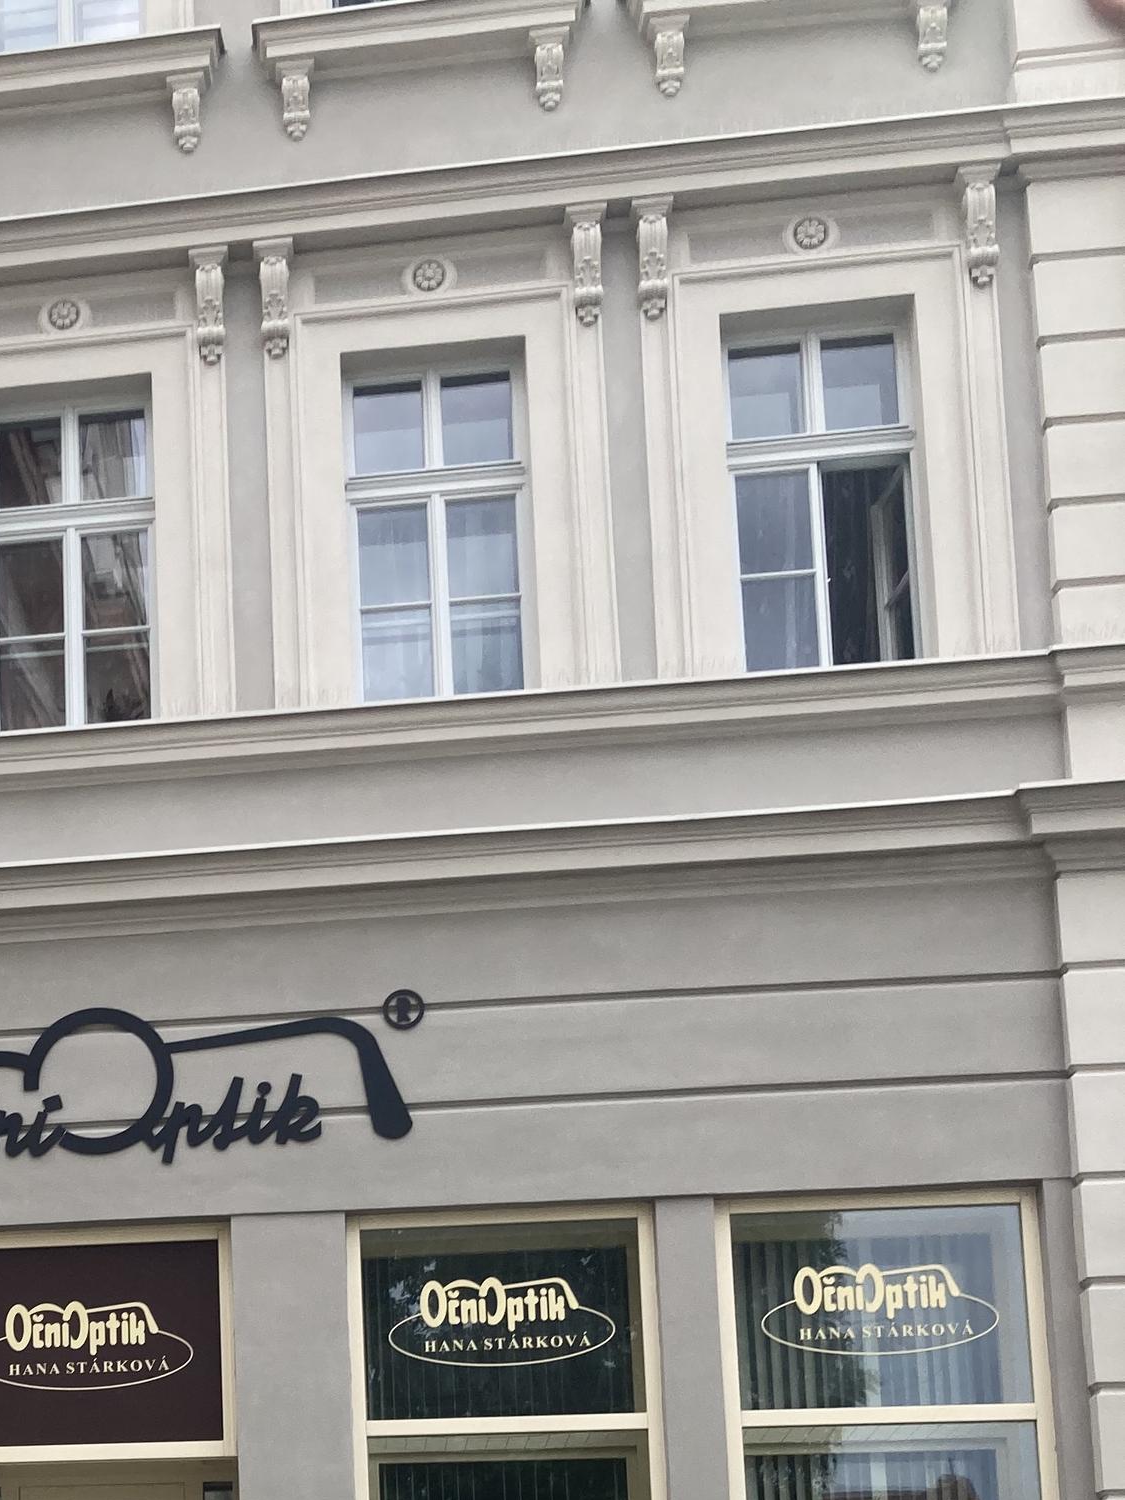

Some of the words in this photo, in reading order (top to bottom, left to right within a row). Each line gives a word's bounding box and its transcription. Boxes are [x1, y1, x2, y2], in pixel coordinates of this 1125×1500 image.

[478, 1276, 566, 1332] Optik
[855, 1263, 947, 1320] Optik
[61, 1300, 146, 1356] Optik
[424, 1338, 478, 1353] HANA
[483, 1331, 592, 1350] STÁRKOVÁ
[799, 1326, 856, 1341] HANA
[862, 1320, 974, 1338] STÁRKOVÁ
[7, 1361, 61, 1376] HANA
[65, 1355, 171, 1374] STÁRKOVÁ
